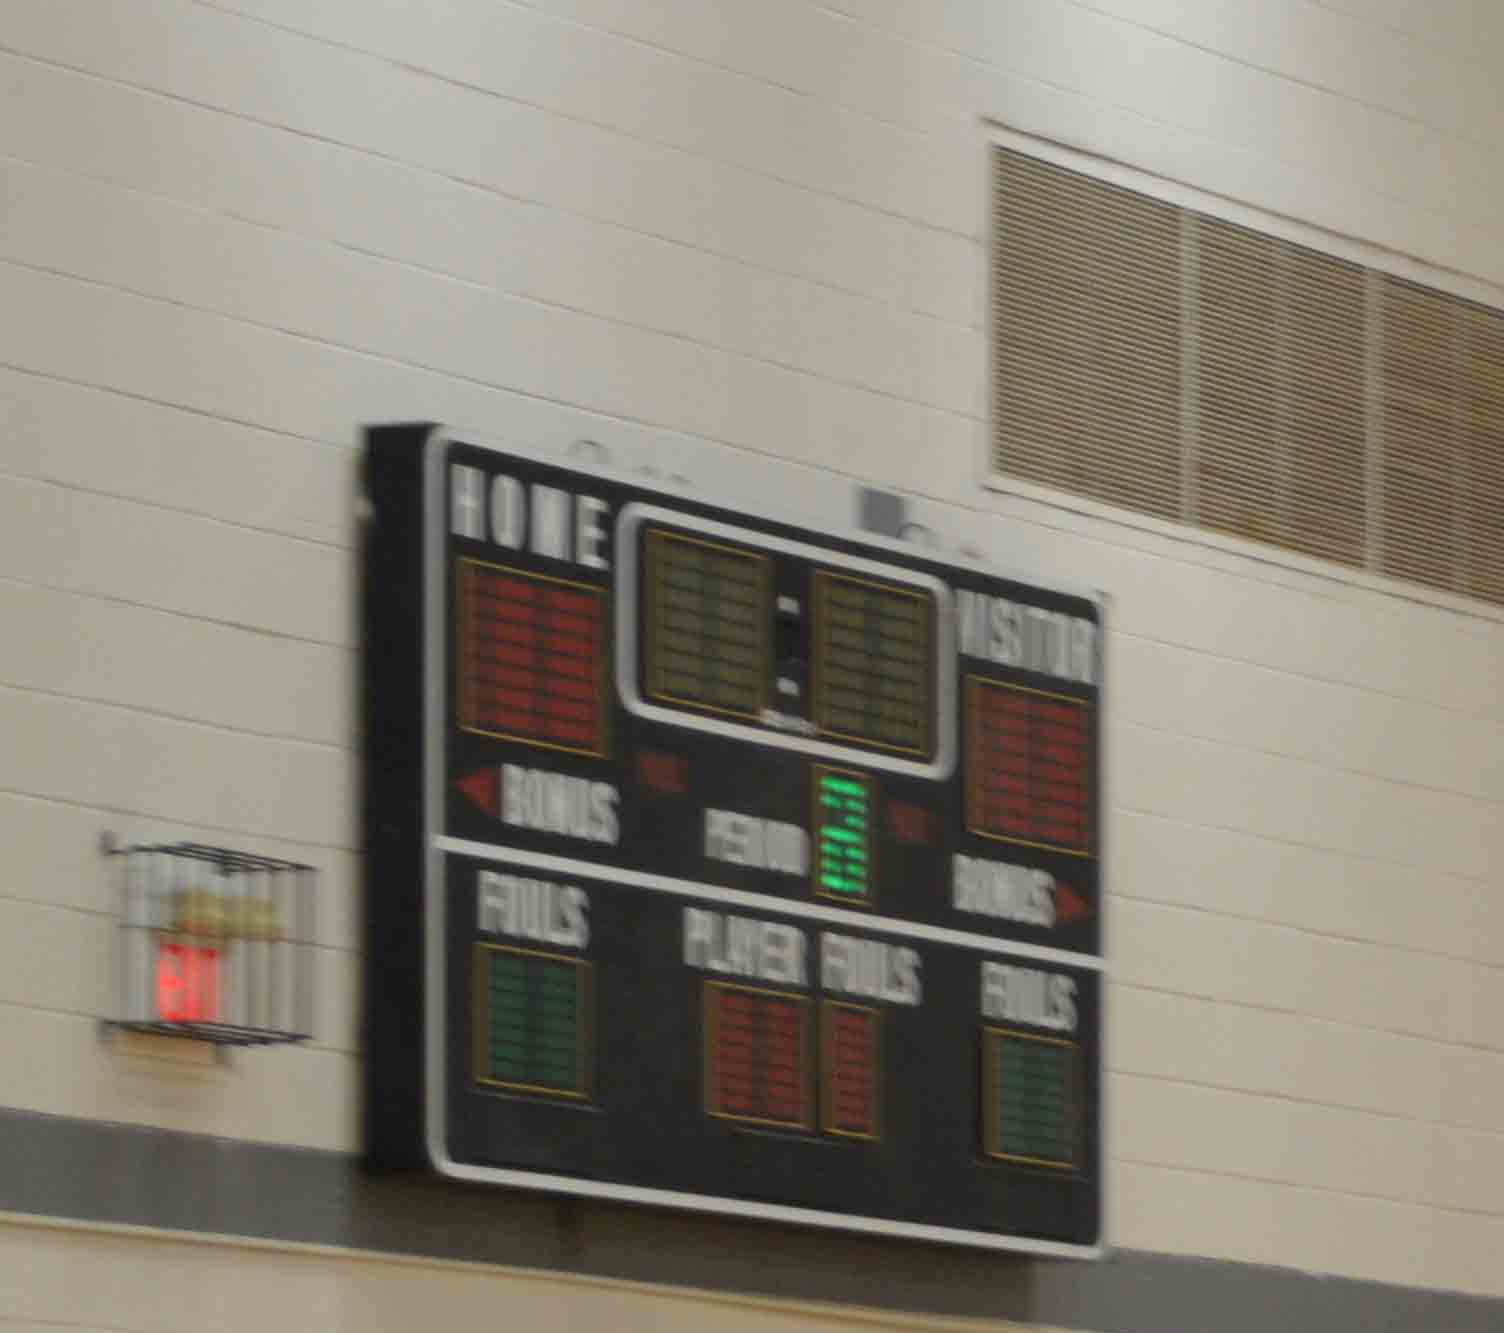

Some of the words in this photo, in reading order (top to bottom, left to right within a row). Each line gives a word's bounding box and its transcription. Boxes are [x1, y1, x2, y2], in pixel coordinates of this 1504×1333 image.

[450, 463, 609, 570] HOME
[500, 763, 620, 845] BONUS
[704, 807, 811, 878] PERIOD
[477, 869, 590, 948] FOULS
[953, 852, 1057, 930] BONUS
[683, 906, 807, 984] PLAYER
[820, 931, 922, 1006] FOULS
[982, 960, 1078, 1032] FOULS
